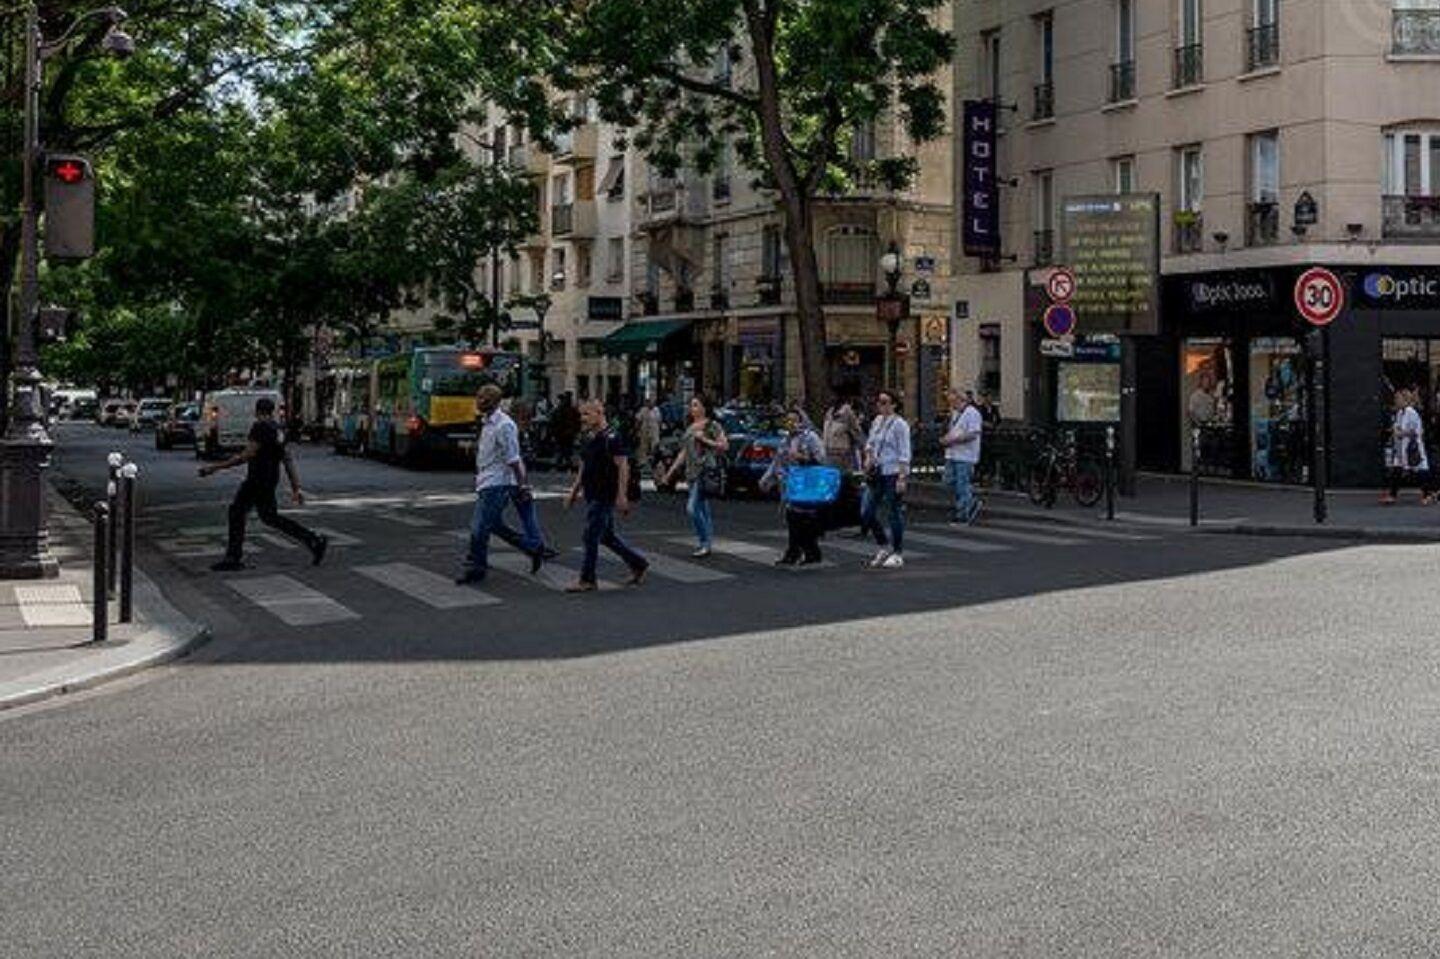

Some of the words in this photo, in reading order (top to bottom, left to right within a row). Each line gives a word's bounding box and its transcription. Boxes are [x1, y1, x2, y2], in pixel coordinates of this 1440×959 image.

[971, 116, 990, 235] HOTEL
[1307, 285, 1331, 308] 30
[1377, 274, 1438, 300] Optic
